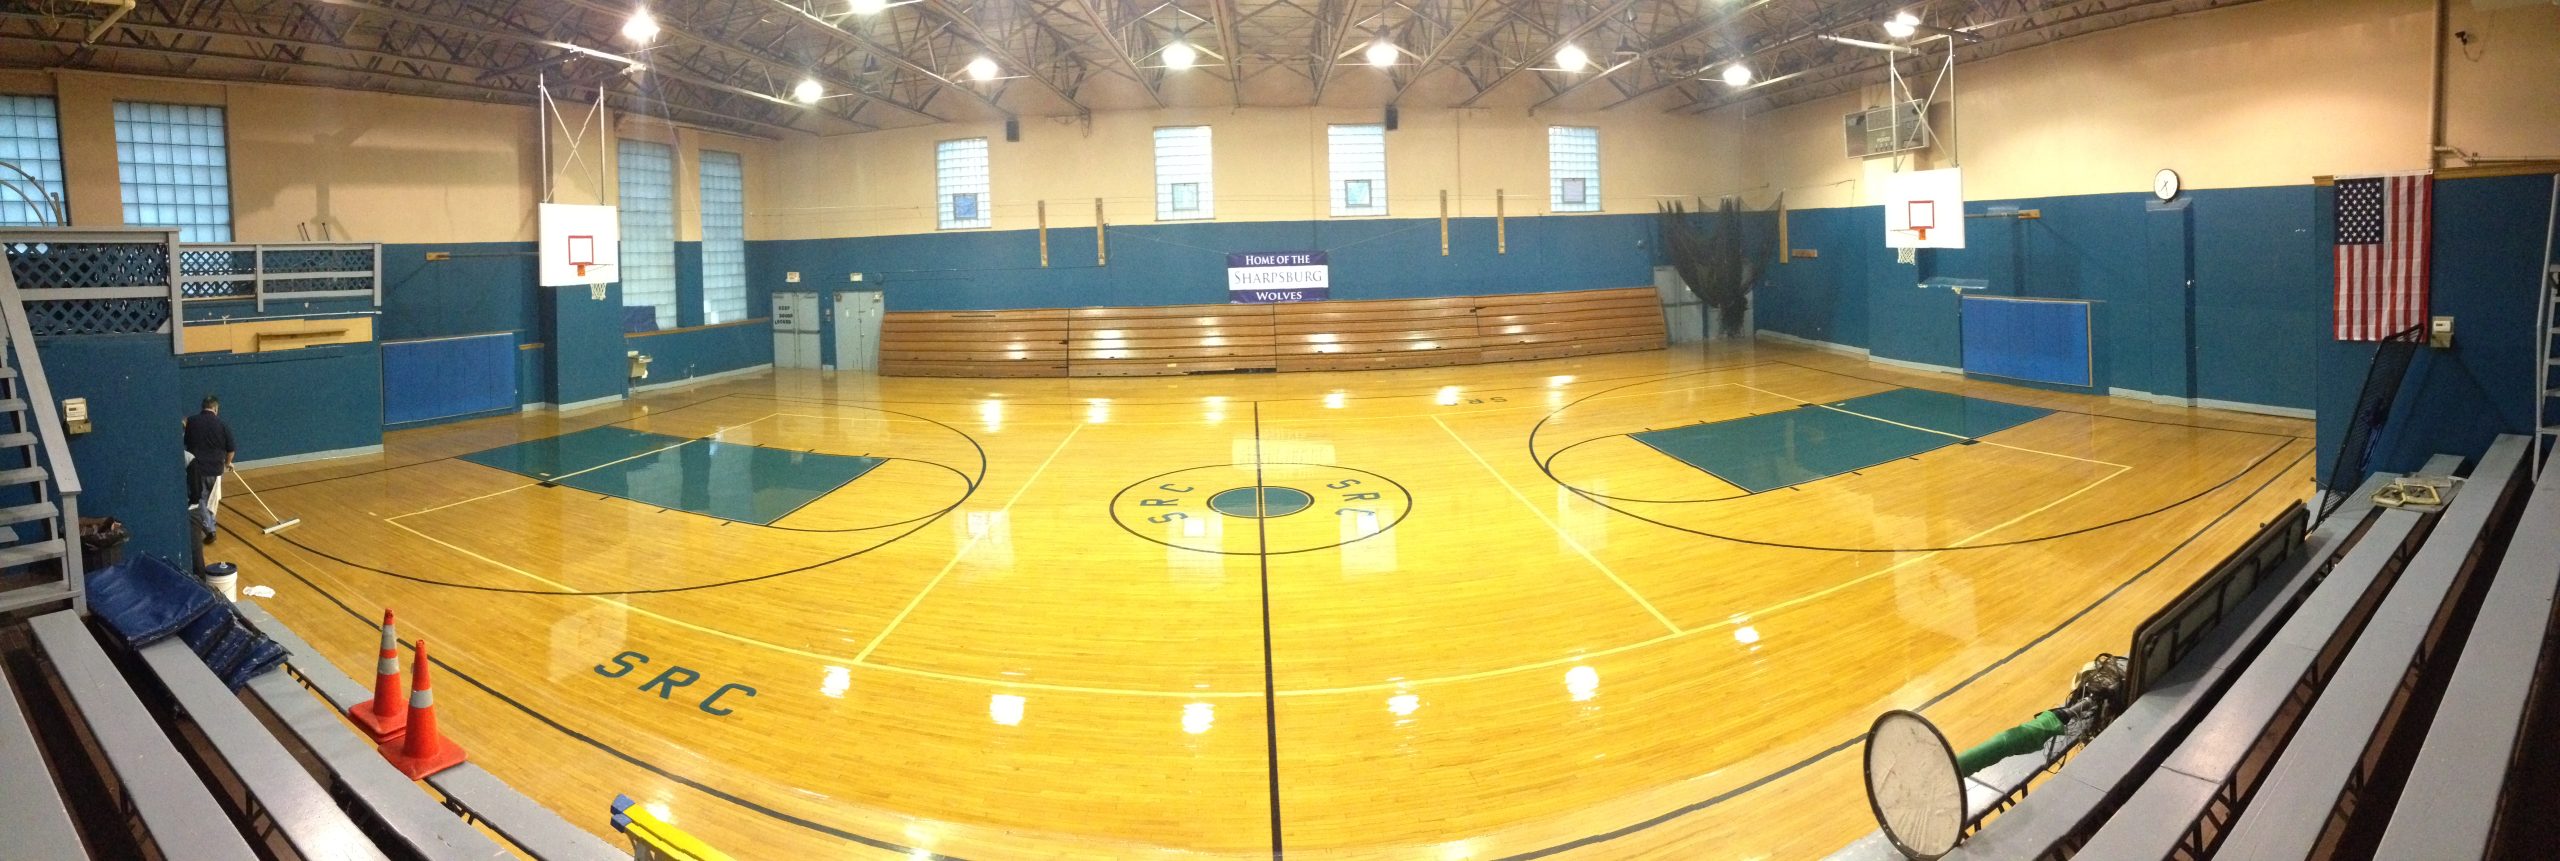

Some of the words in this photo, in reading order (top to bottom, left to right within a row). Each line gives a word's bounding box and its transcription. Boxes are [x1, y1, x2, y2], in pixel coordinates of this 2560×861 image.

[1245, 255, 1275, 266] HOME
[1276, 255, 1290, 264] OF
[1290, 254, 1311, 264] THE
[1234, 270, 1322, 285] SHARPSBURG
[1256, 291, 1303, 301] WOLVES
[1139, 483, 1194, 524] SRC
[593, 651, 757, 716] SRC
